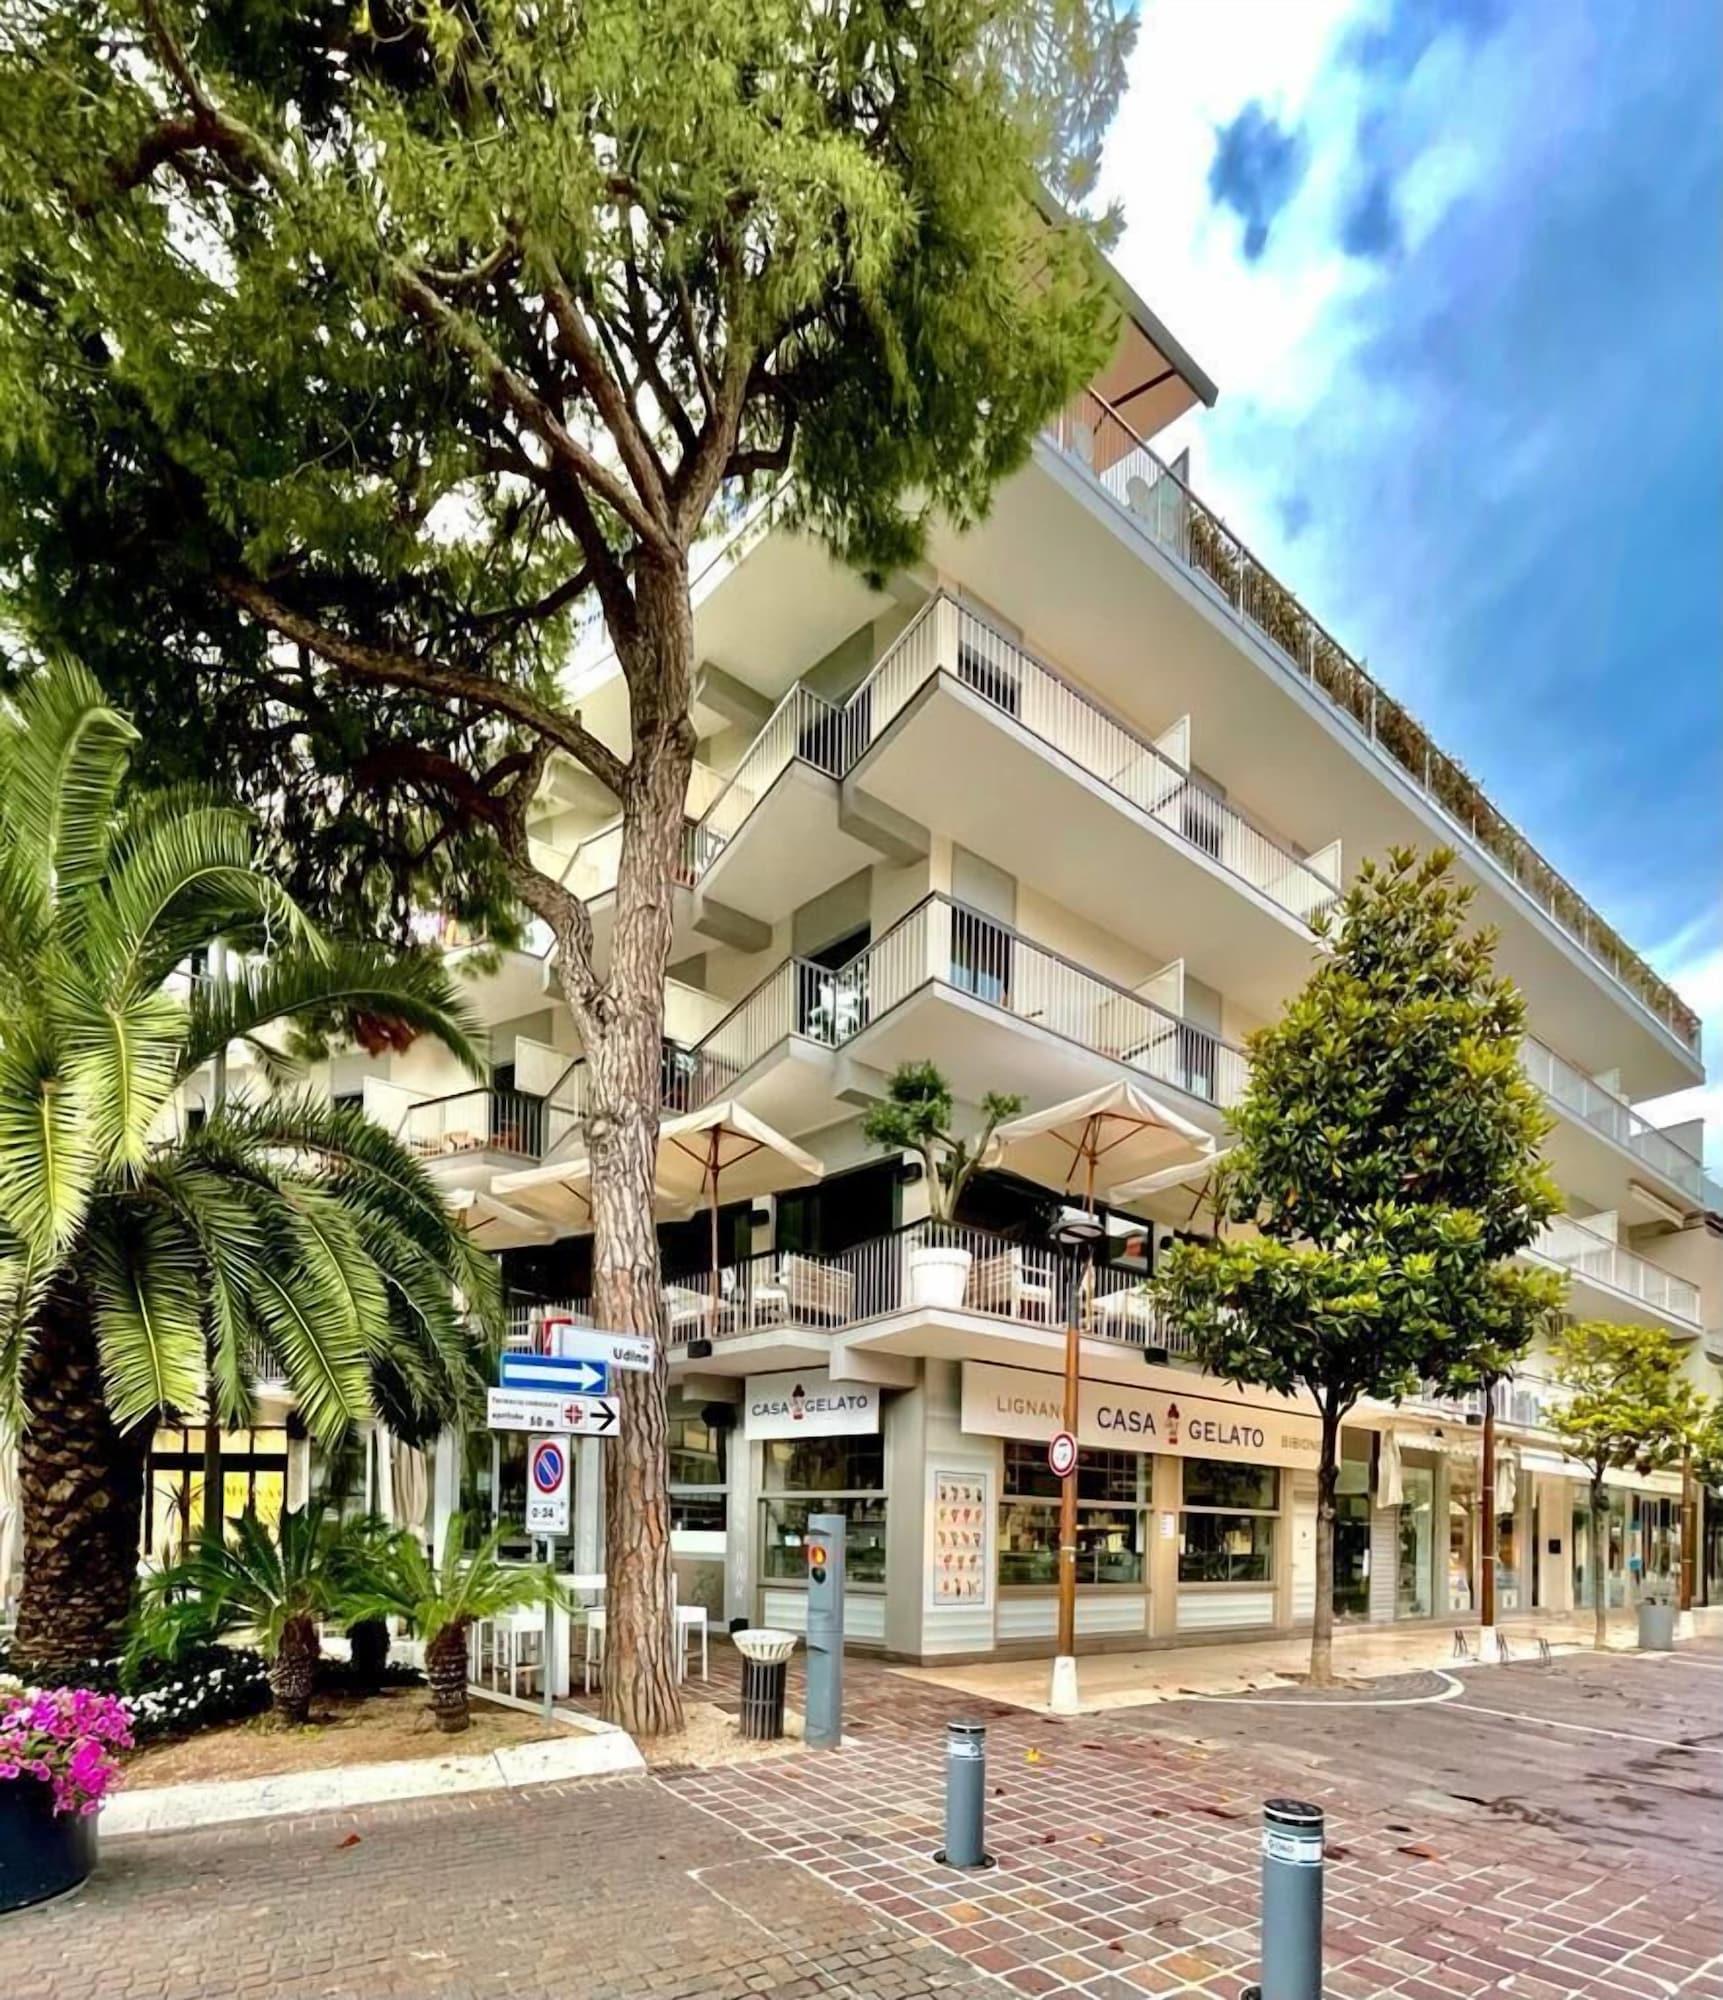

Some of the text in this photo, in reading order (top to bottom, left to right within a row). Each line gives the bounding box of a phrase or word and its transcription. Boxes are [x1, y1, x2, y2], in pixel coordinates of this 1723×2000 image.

[613, 1347, 649, 1365] Udine
[752, 1396, 868, 1416] CASA GELATO
[997, 1395, 1064, 1419] LIGNAN
[1097, 1406, 1264, 1448] CASA GELATO
